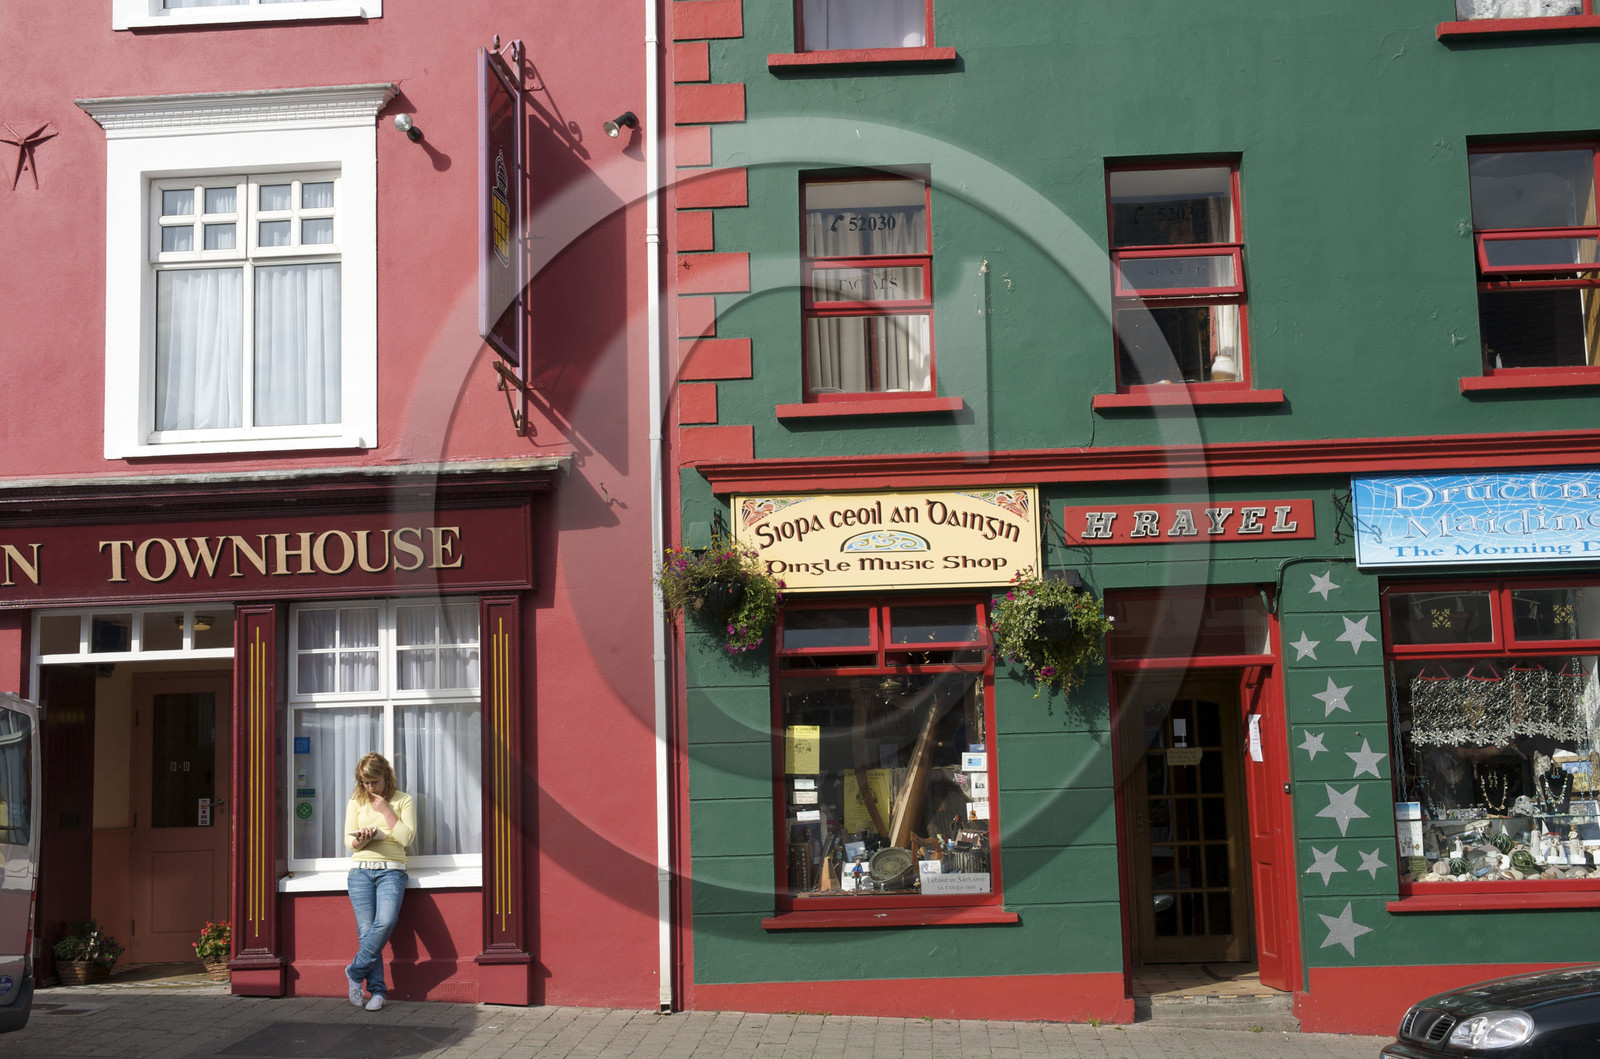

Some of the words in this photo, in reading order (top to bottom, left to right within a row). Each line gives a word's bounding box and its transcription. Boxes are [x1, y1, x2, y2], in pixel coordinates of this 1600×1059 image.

[848, 215, 897, 231] 52030
[839, 277, 898, 291] FACALS
[1559, 482, 1600, 501] n
[1081, 512, 1117, 539] H
[1130, 505, 1298, 538] RAYEL
[99, 526, 463, 583] TOWNHOUSE
[1389, 545, 1444, 558] The
[1454, 542, 1572, 556] Morning
[858, 557, 934, 572] Music
[942, 555, 1008, 571] Shop
